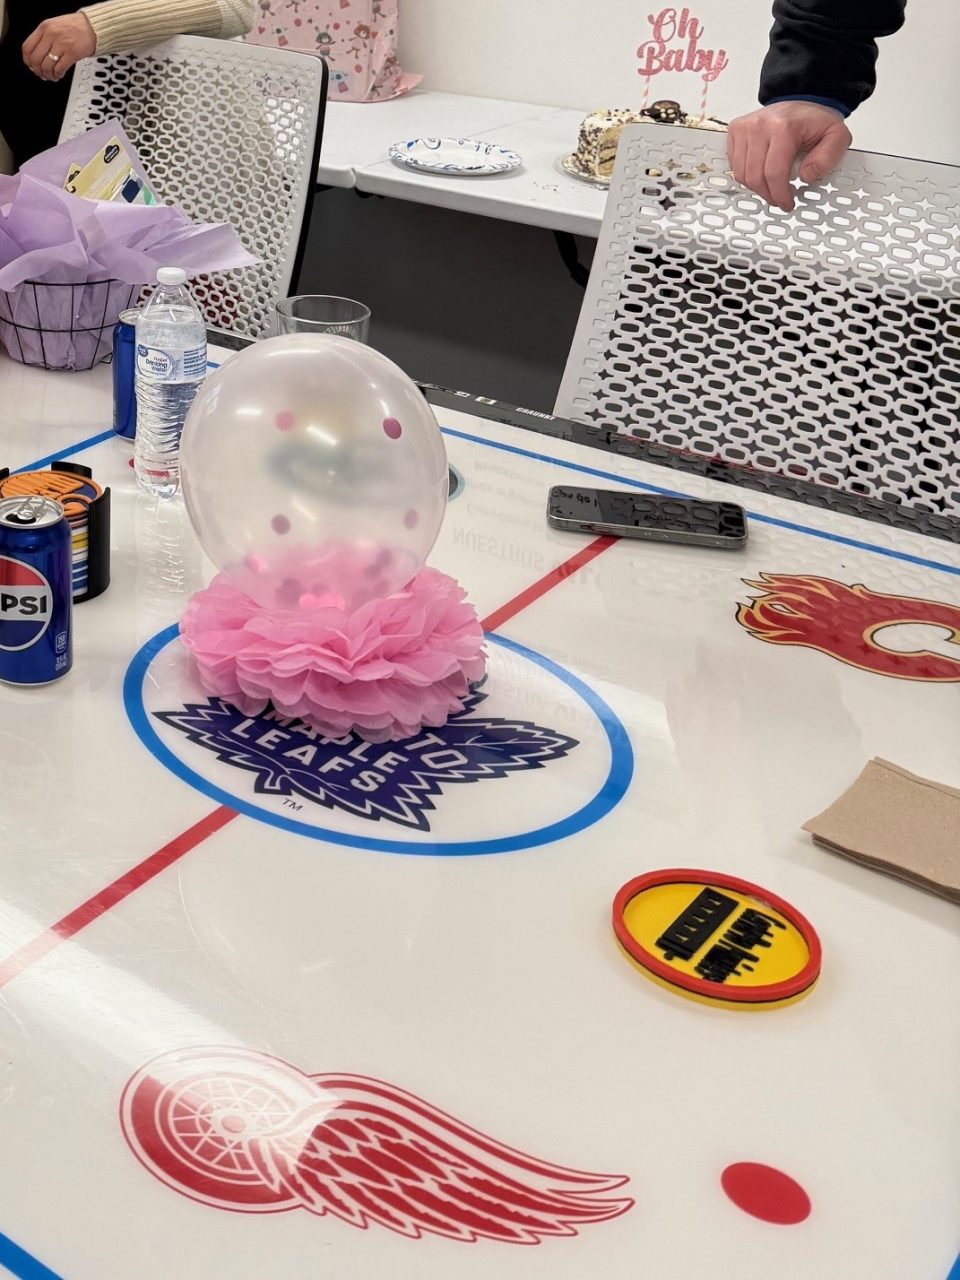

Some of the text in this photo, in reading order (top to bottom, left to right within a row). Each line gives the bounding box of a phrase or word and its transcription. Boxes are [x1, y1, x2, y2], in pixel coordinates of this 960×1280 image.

[647, 8, 704, 42] Oh
[637, 39, 729, 82] Baby
[232, 719, 386, 791] LEAFS
